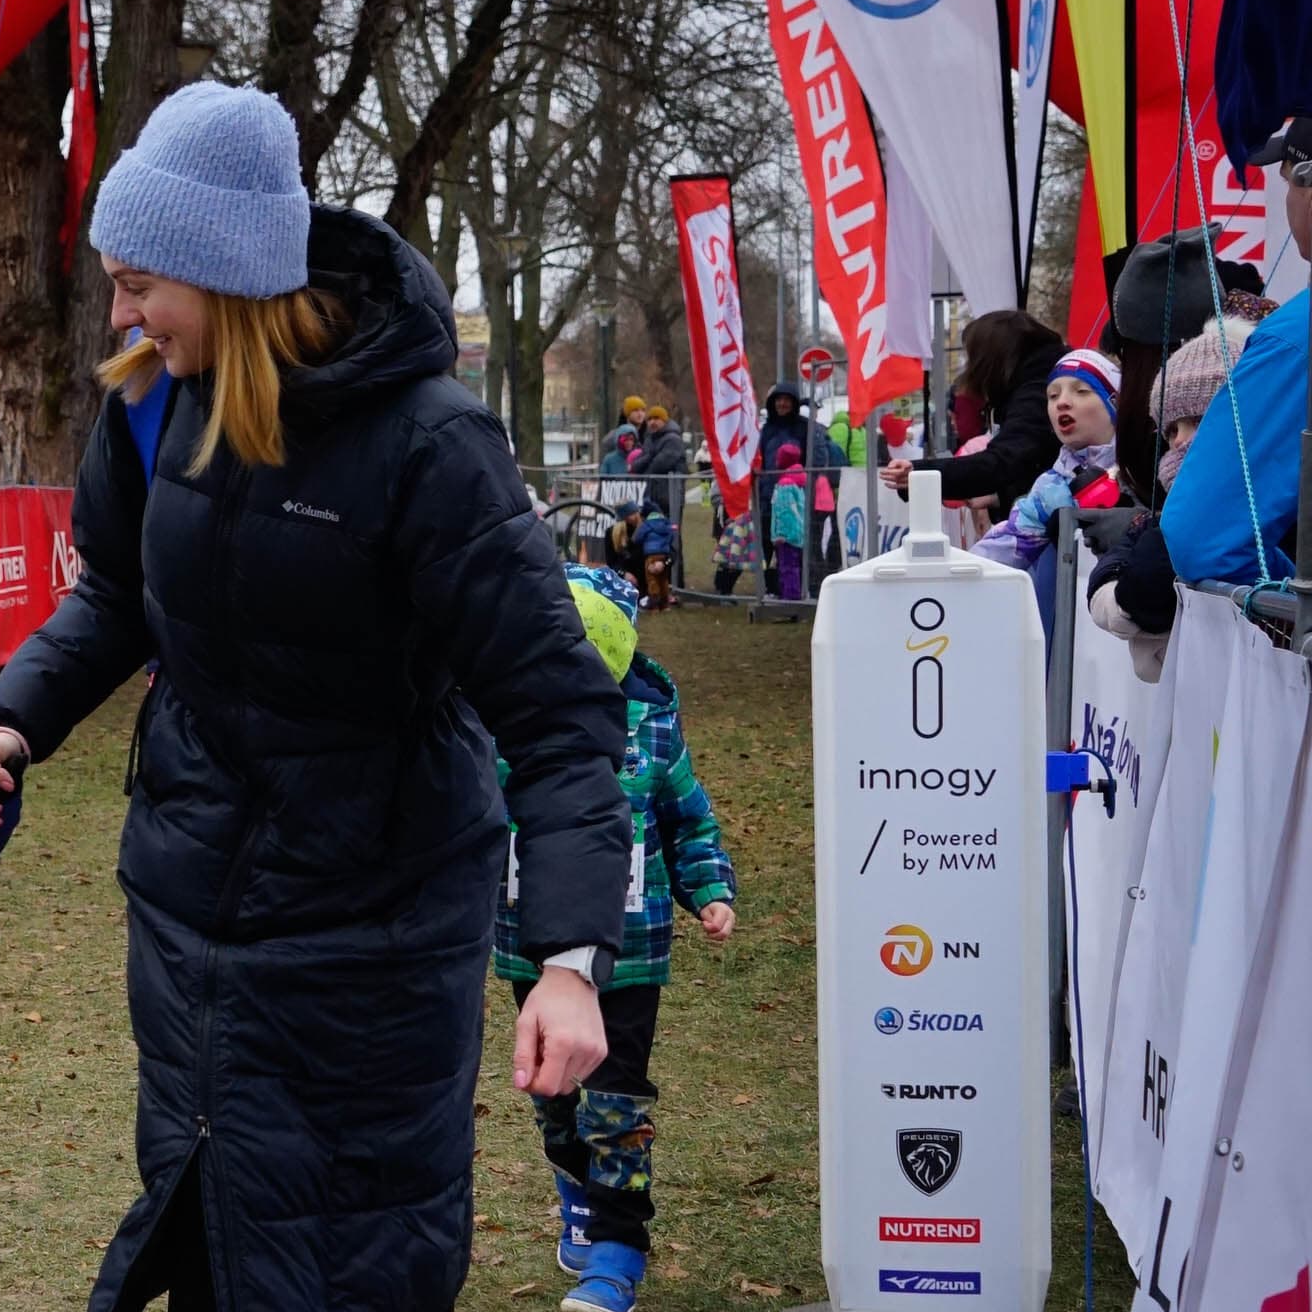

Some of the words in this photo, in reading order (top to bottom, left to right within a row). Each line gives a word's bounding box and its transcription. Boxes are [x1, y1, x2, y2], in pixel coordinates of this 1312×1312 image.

[293, 502, 340, 522] Columbia
[859, 759, 997, 797] innogy
[903, 827, 998, 846] Powered
[903, 852, 929, 876] by
[939, 853, 996, 870] MVM
[943, 942, 980, 959] NN
[907, 1010, 984, 1031] ŠKODA
[899, 1084, 977, 1100] RUNTO
[902, 1134, 956, 1142] PEUGEOT
[884, 1222, 977, 1238] NUTREND
